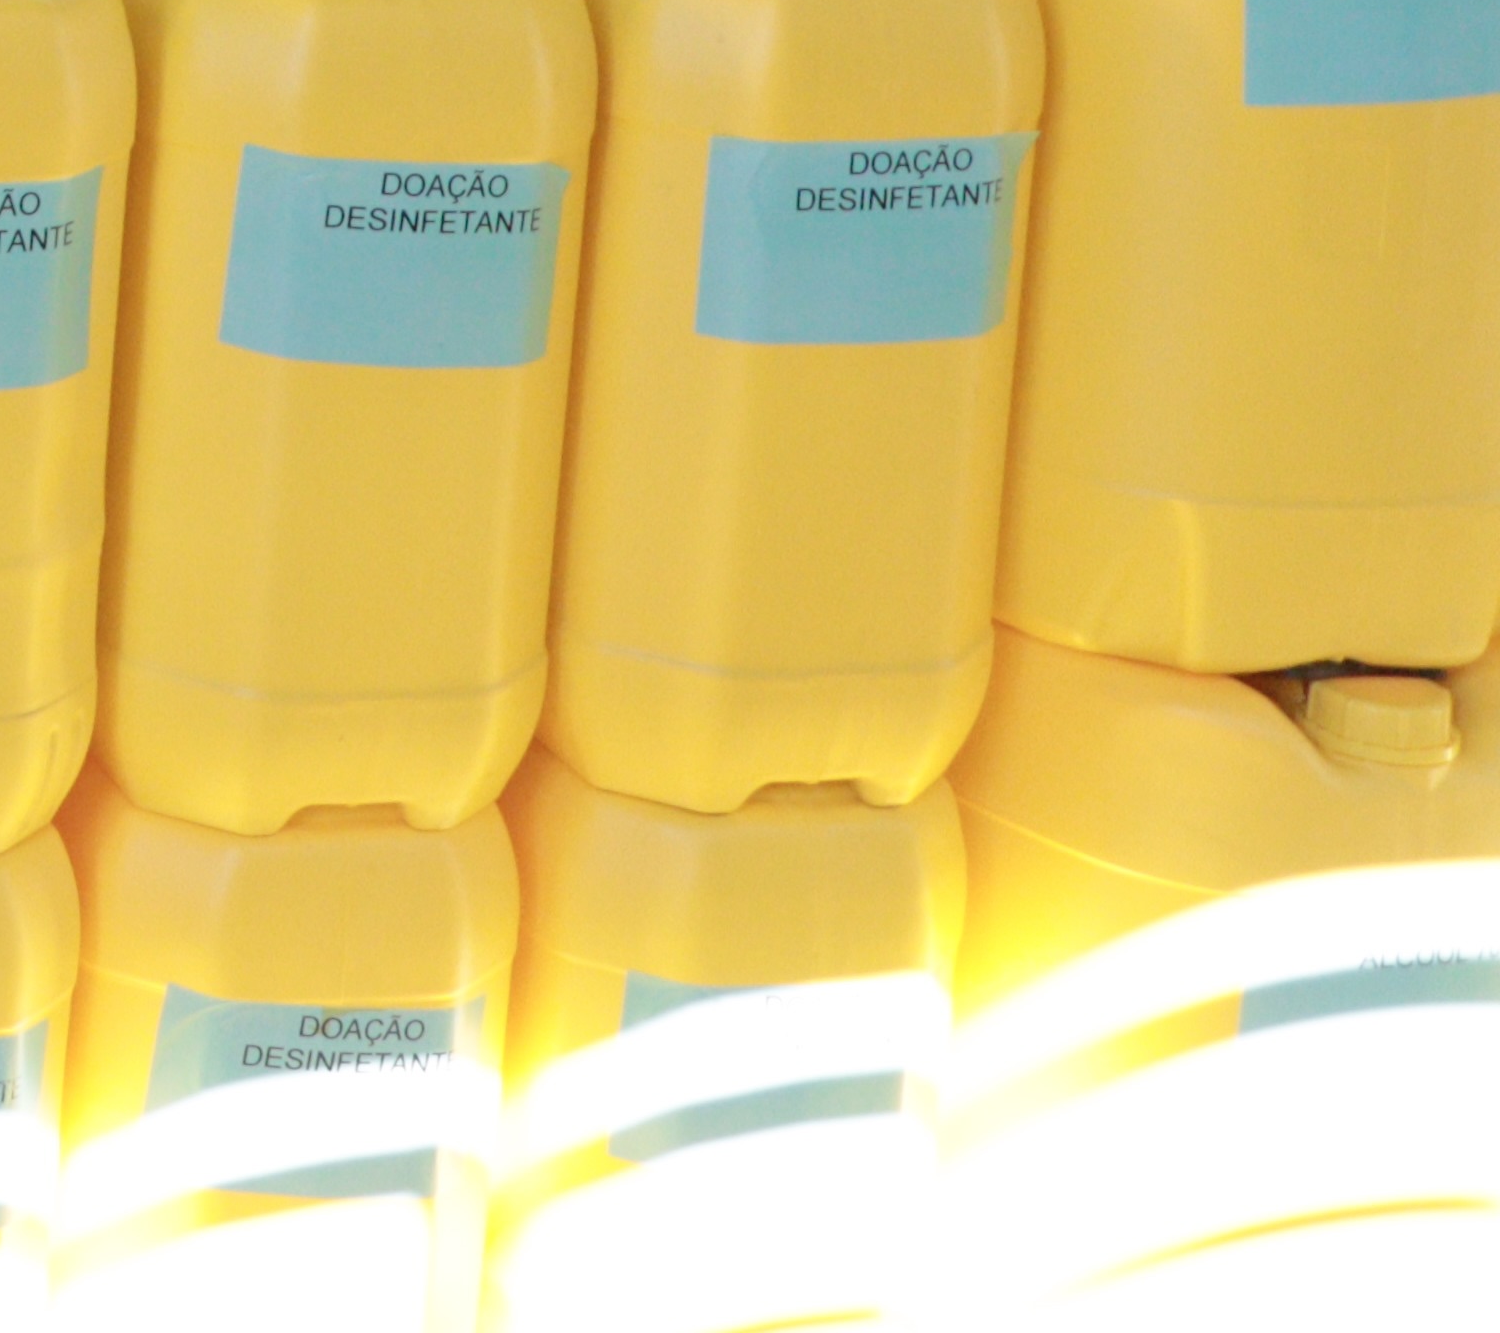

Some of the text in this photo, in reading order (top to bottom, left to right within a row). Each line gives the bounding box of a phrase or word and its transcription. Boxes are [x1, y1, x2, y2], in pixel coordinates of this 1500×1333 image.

[849, 145, 973, 179] DOAÇÃO
[381, 169, 509, 204] DOAÇÃO
[795, 178, 1004, 213] DESINFETANTE
[324, 204, 541, 236] DESINFETANTE
[299, 1015, 425, 1046] DOAÇÃO
